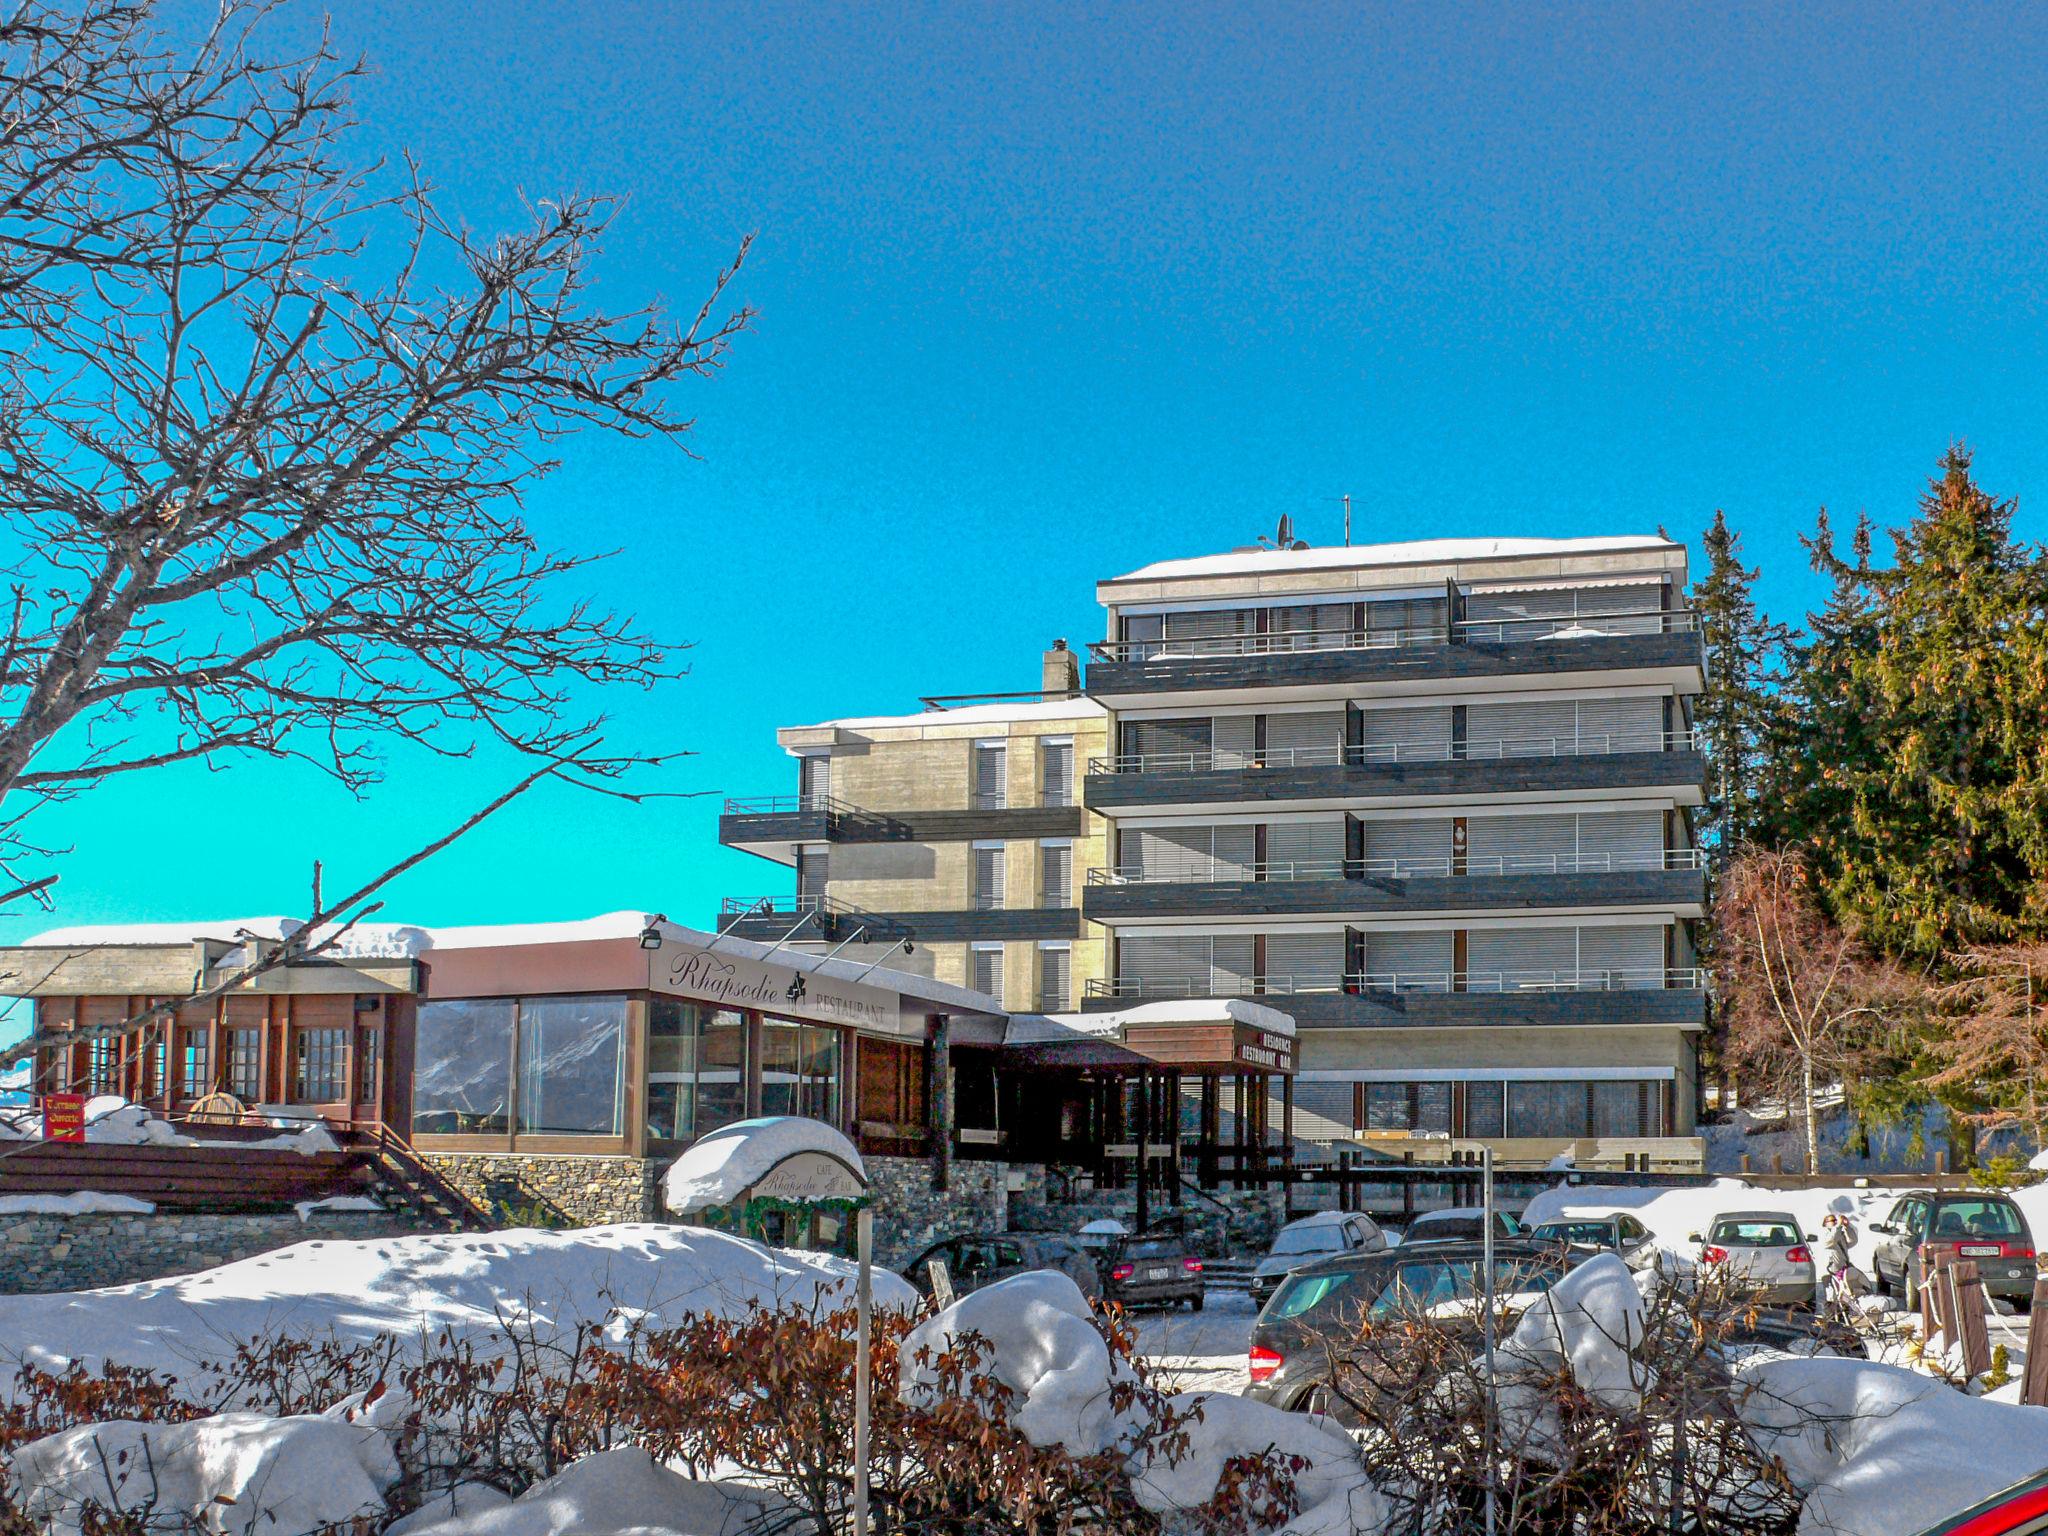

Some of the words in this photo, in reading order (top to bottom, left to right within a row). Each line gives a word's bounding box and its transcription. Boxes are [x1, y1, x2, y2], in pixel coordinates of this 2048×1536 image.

[670, 952, 778, 1004] Rhapsodie
[816, 993, 886, 1023] RESTAURANT
[1242, 1045, 1276, 1067] RESTAURANT
